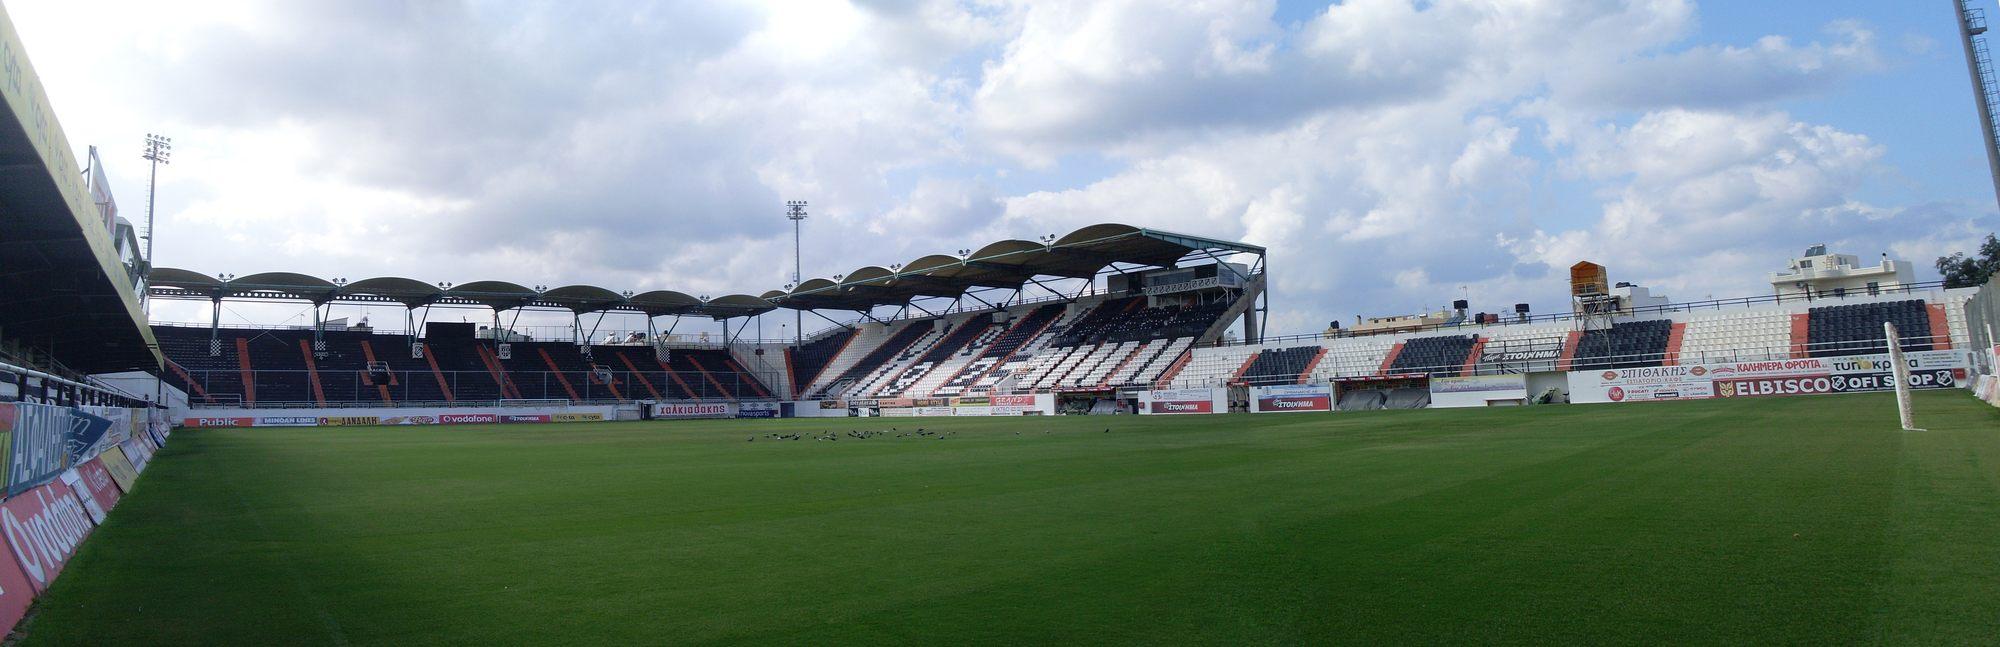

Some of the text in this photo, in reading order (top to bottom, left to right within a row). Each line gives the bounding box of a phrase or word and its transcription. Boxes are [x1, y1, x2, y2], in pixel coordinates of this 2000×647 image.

[1621, 366, 1687, 378] ΣΠΙΘΑΚΗΣ
[1737, 361, 1783, 373] ΚΑΛΗΜΕΡΑ
[1785, 359, 1821, 370] ΦΡΟΥΤΑ
[1736, 378, 1830, 396] ELBISCO
[1848, 374, 1933, 388] OFI SOP
[199, 418, 240, 427] Public
[451, 415, 493, 423] vodafone
[23, 484, 92, 569] vodafone
